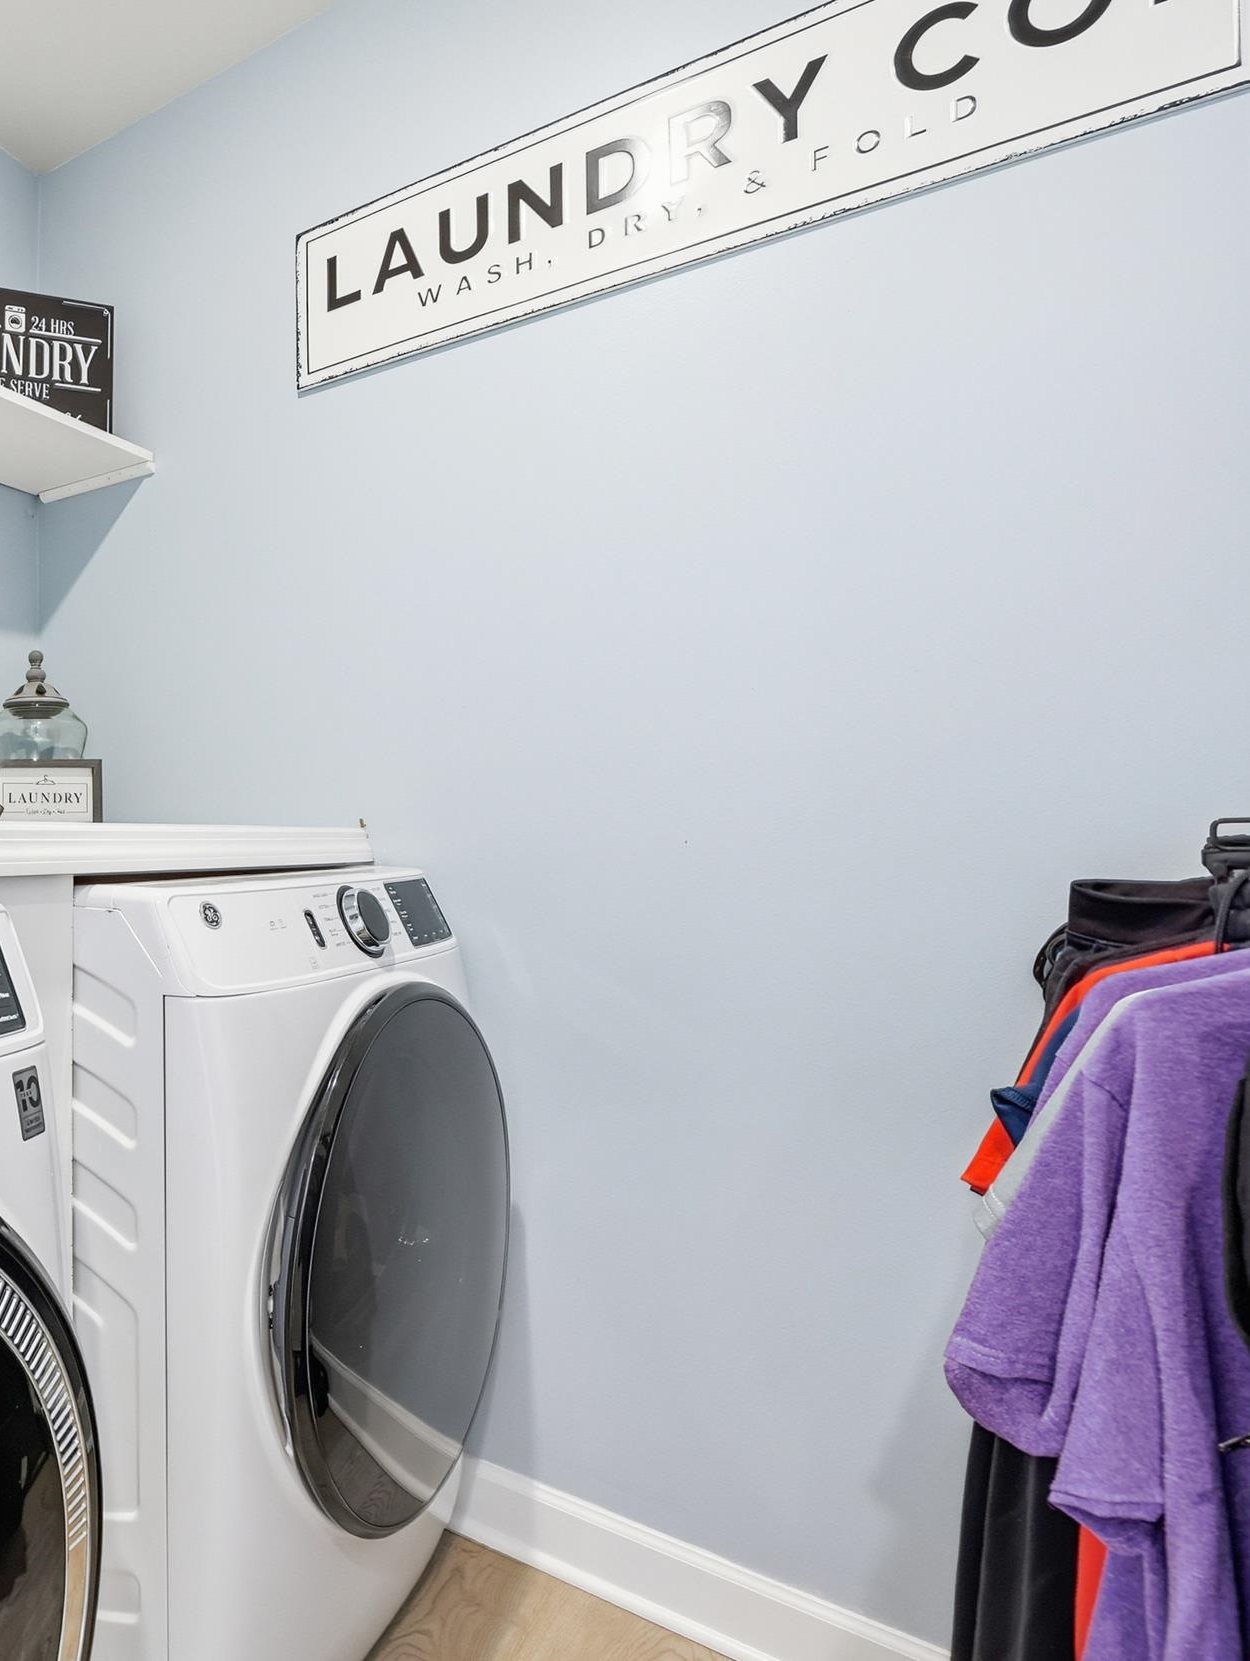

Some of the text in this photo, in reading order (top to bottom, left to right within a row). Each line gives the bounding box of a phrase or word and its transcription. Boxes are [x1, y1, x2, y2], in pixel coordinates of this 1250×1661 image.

[325, 54, 829, 312] LAUNDRY
[417, 93, 977, 309] WASH, DRY, & FOLD
[31, 315, 46, 333] 24
[50, 319, 75, 336] HRS
[10, 378, 50, 400] SERVE
[8, 792, 82, 804] LAUNDRY
